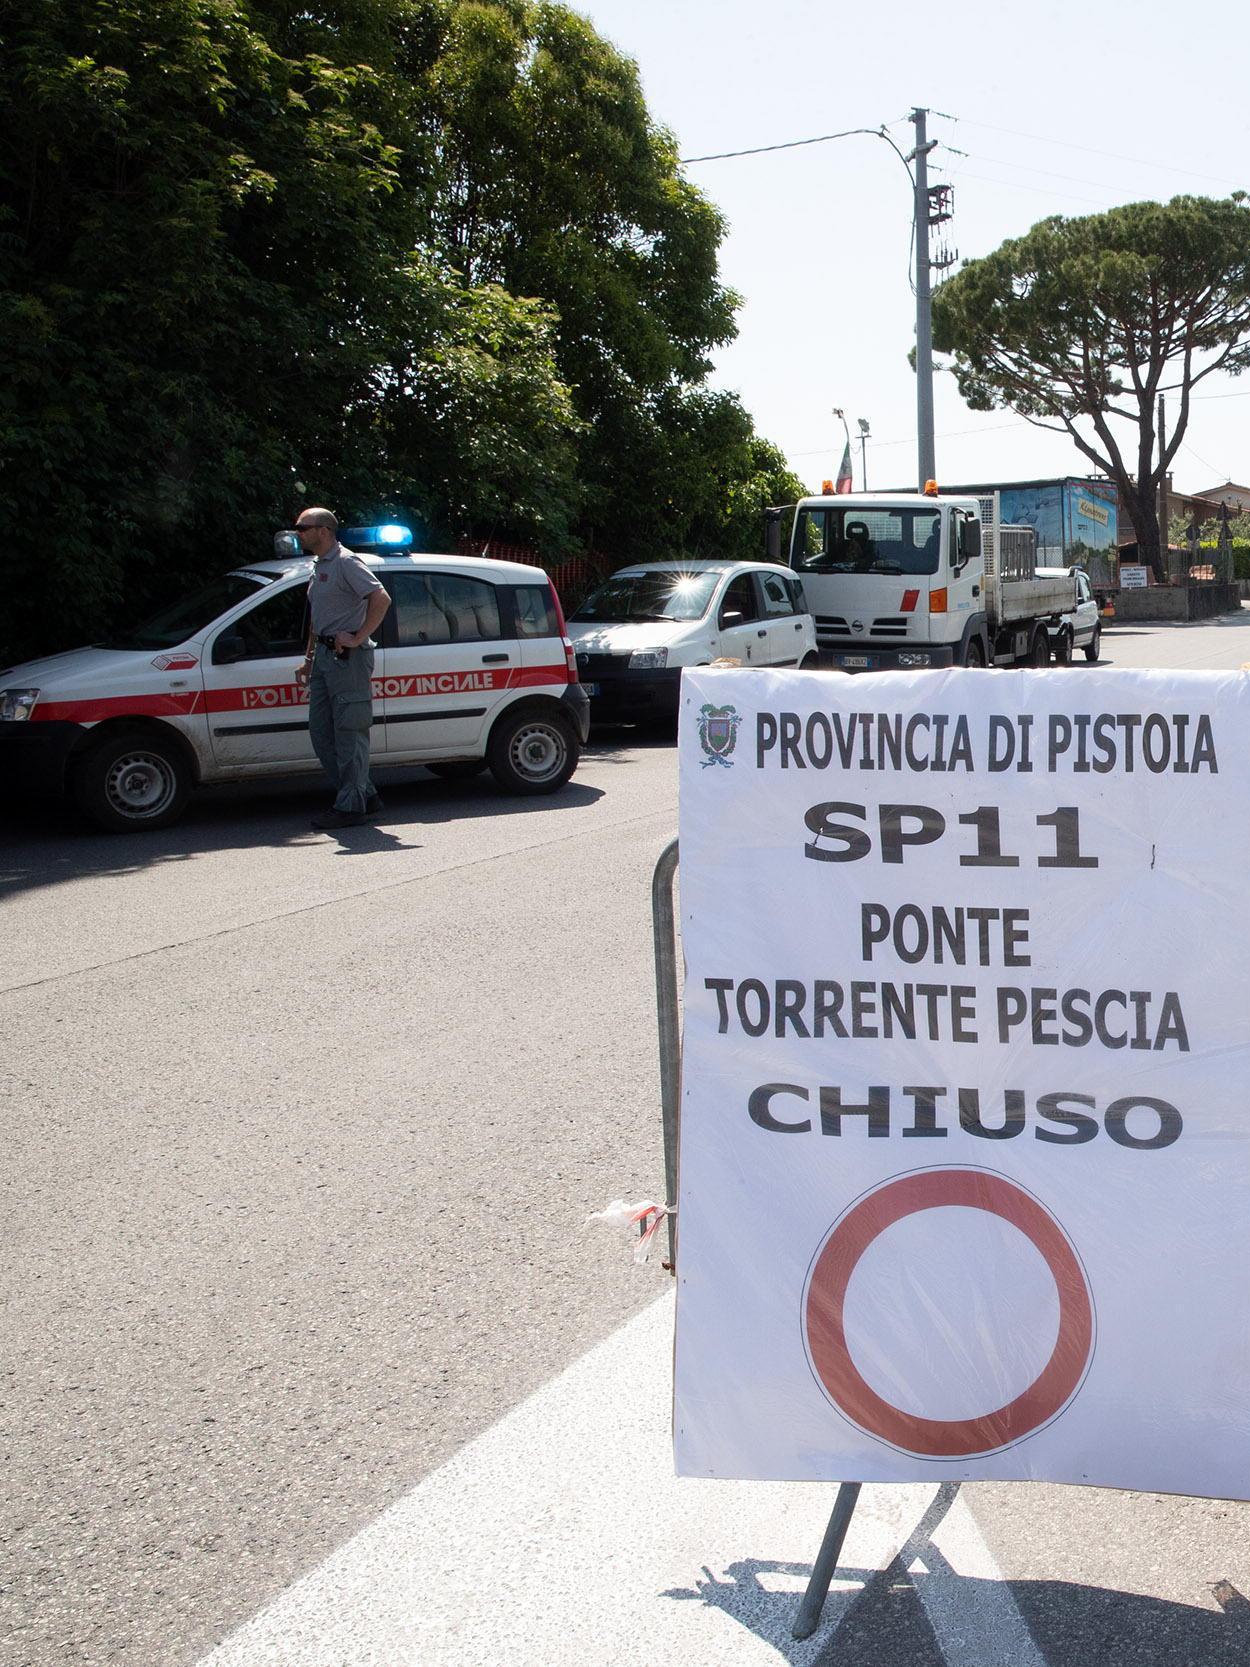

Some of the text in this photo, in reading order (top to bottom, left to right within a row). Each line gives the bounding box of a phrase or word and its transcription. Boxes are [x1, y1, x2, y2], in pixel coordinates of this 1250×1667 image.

[242, 672, 494, 708] POLIZ ROVINCIALE
[756, 711, 1219, 774] PROVINCIA DI PISTOIA
[804, 800, 1099, 868] SP11
[860, 902, 1032, 967] PONTE
[703, 977, 1191, 1052] TORRENTE PESCIA
[747, 1081, 1185, 1150] CHIUSO
